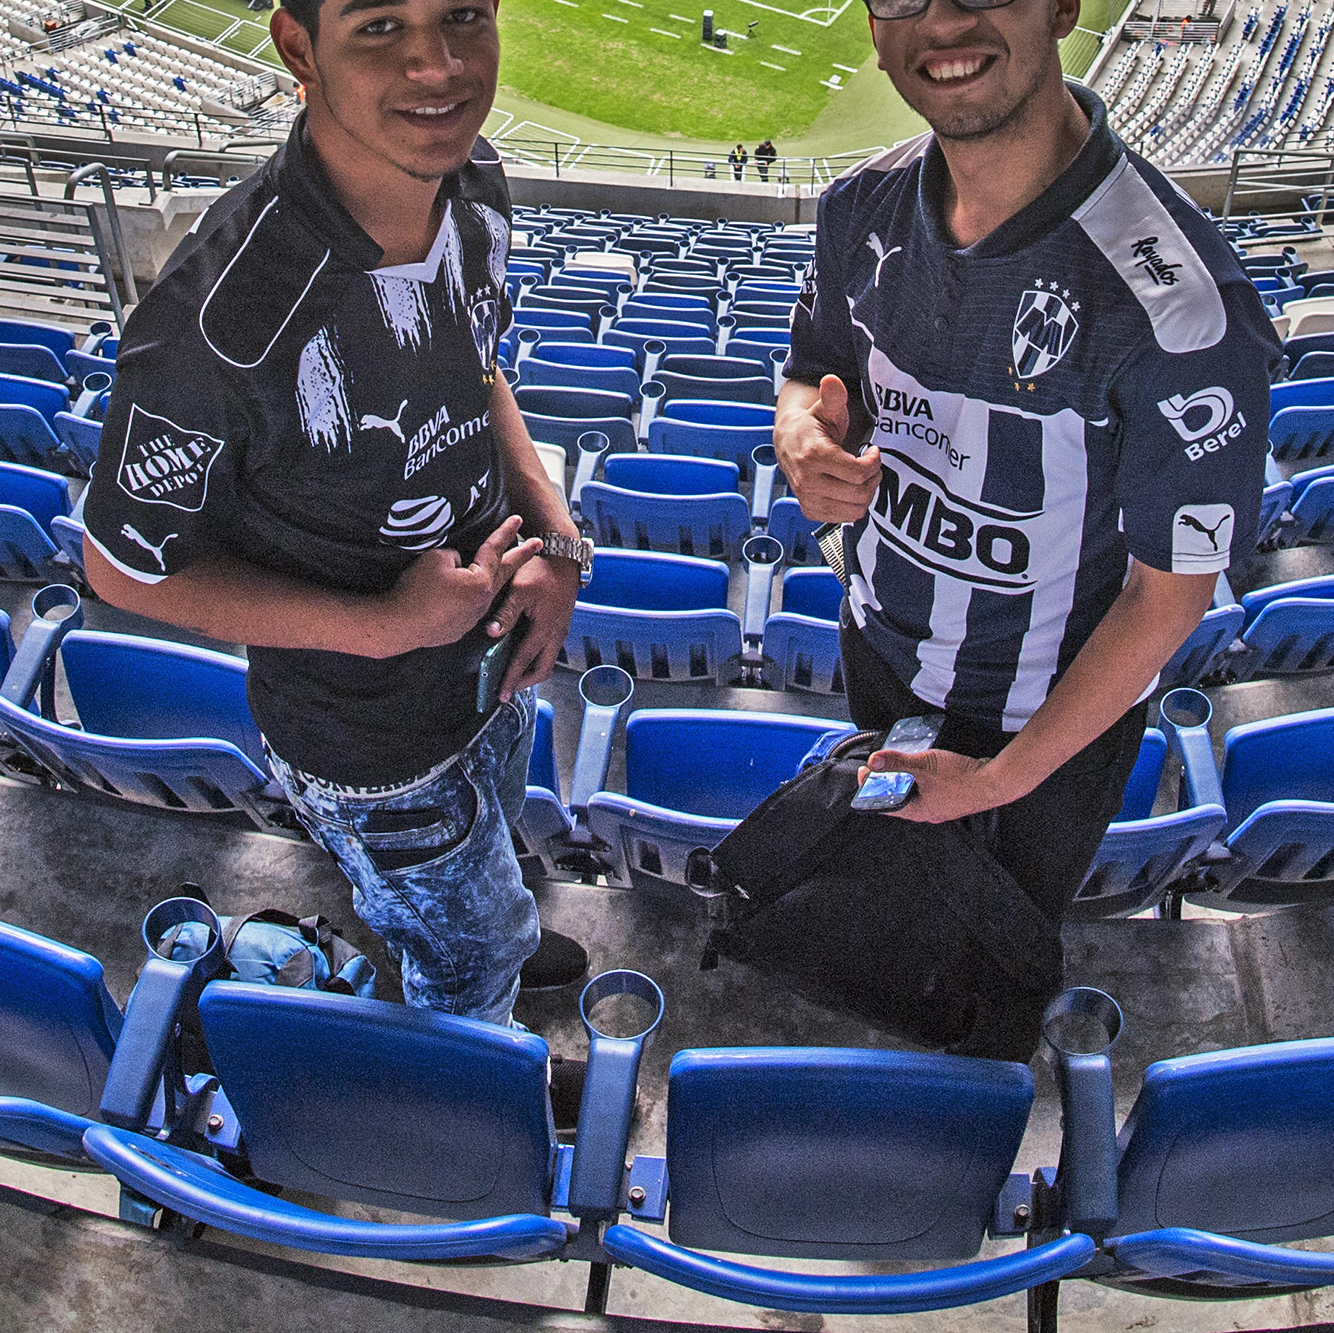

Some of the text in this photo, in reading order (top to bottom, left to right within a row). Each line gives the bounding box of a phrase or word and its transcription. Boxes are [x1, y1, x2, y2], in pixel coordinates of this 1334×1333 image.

[1131, 236, 1183, 286] Rayados
[137, 434, 175, 457] THE
[404, 410, 490, 480] Bancome
[408, 405, 450, 459] BBVA
[875, 416, 970, 470] ancomer
[1184, 411, 1247, 462] Berel
[125, 437, 211, 491] HOME
[150, 461, 203, 497] DEPOT
[874, 462, 1030, 575] MBO
